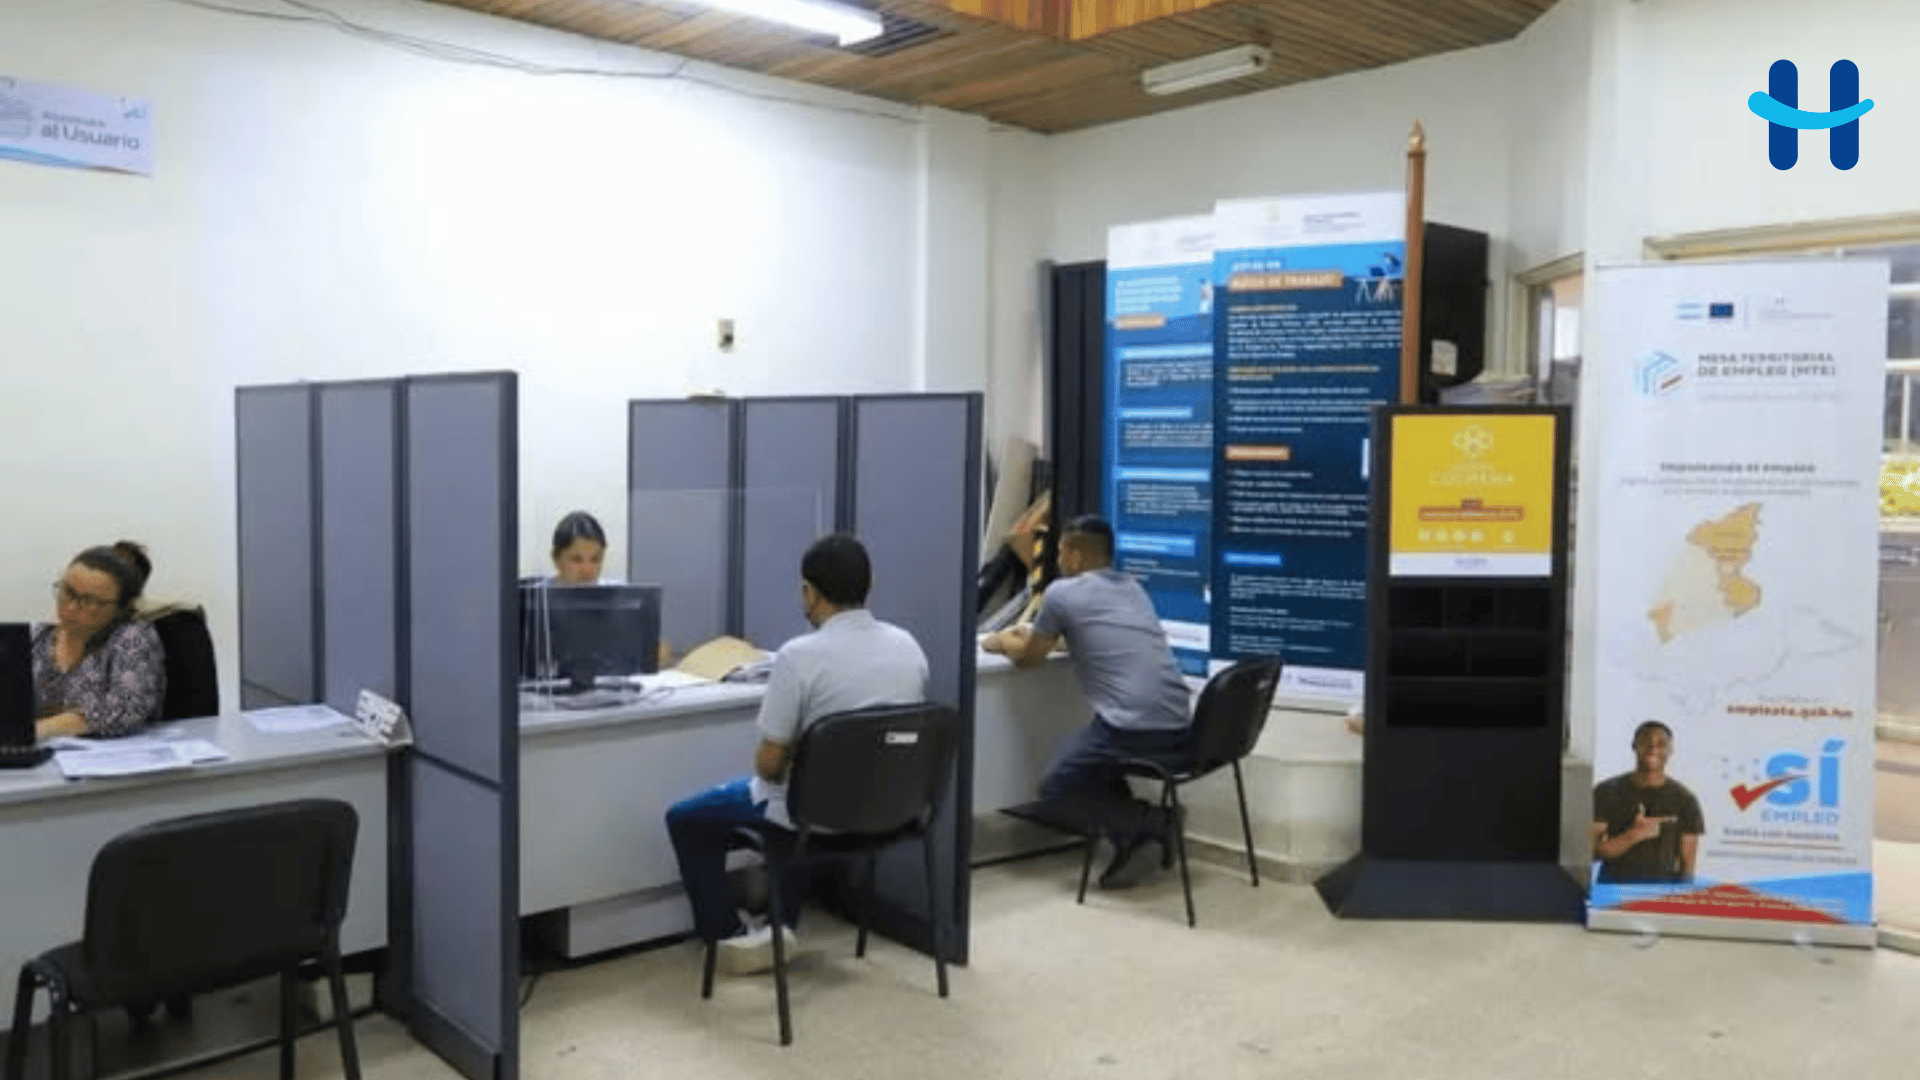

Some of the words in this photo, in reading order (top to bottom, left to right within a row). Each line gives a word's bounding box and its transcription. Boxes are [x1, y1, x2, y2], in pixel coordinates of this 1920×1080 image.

[41, 122, 59, 139] al
[62, 123, 140, 151] Usuario
[1722, 365, 1788, 377] EMPLEO
[1759, 811, 1840, 825] EMPLEO
